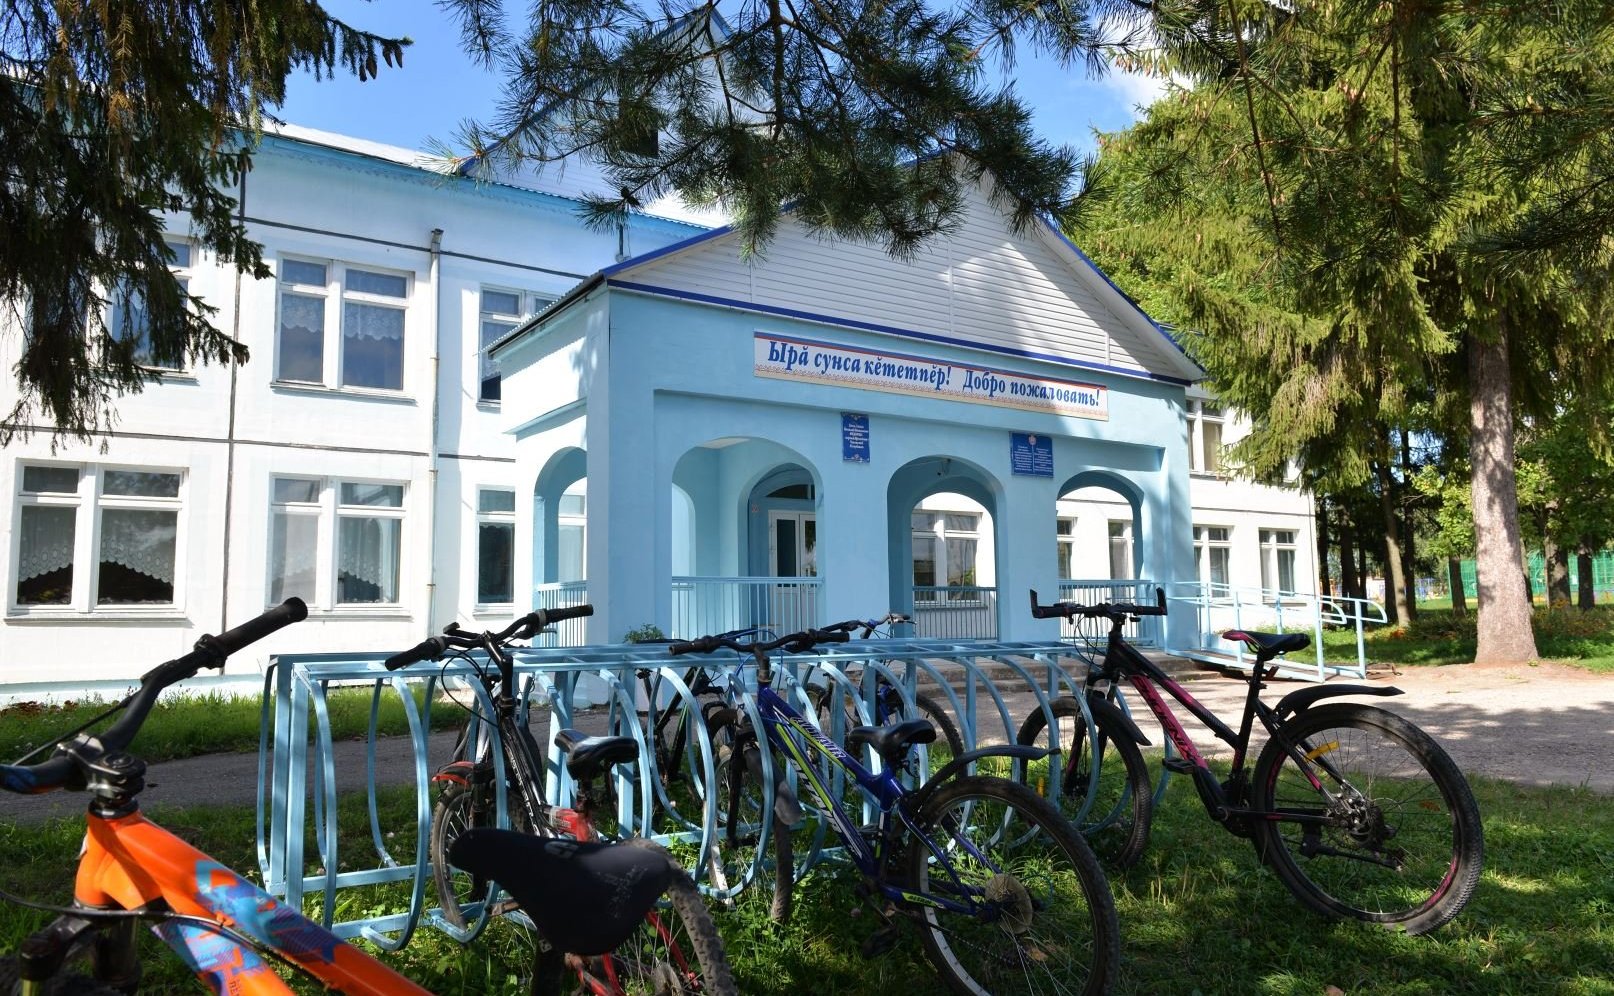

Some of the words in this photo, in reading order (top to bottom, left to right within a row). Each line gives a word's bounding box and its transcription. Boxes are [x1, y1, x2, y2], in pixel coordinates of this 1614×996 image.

[814, 352, 861, 374] сунса
[963, 370, 1006, 397] Добро
[1010, 382, 1100, 407] пожаловать!
